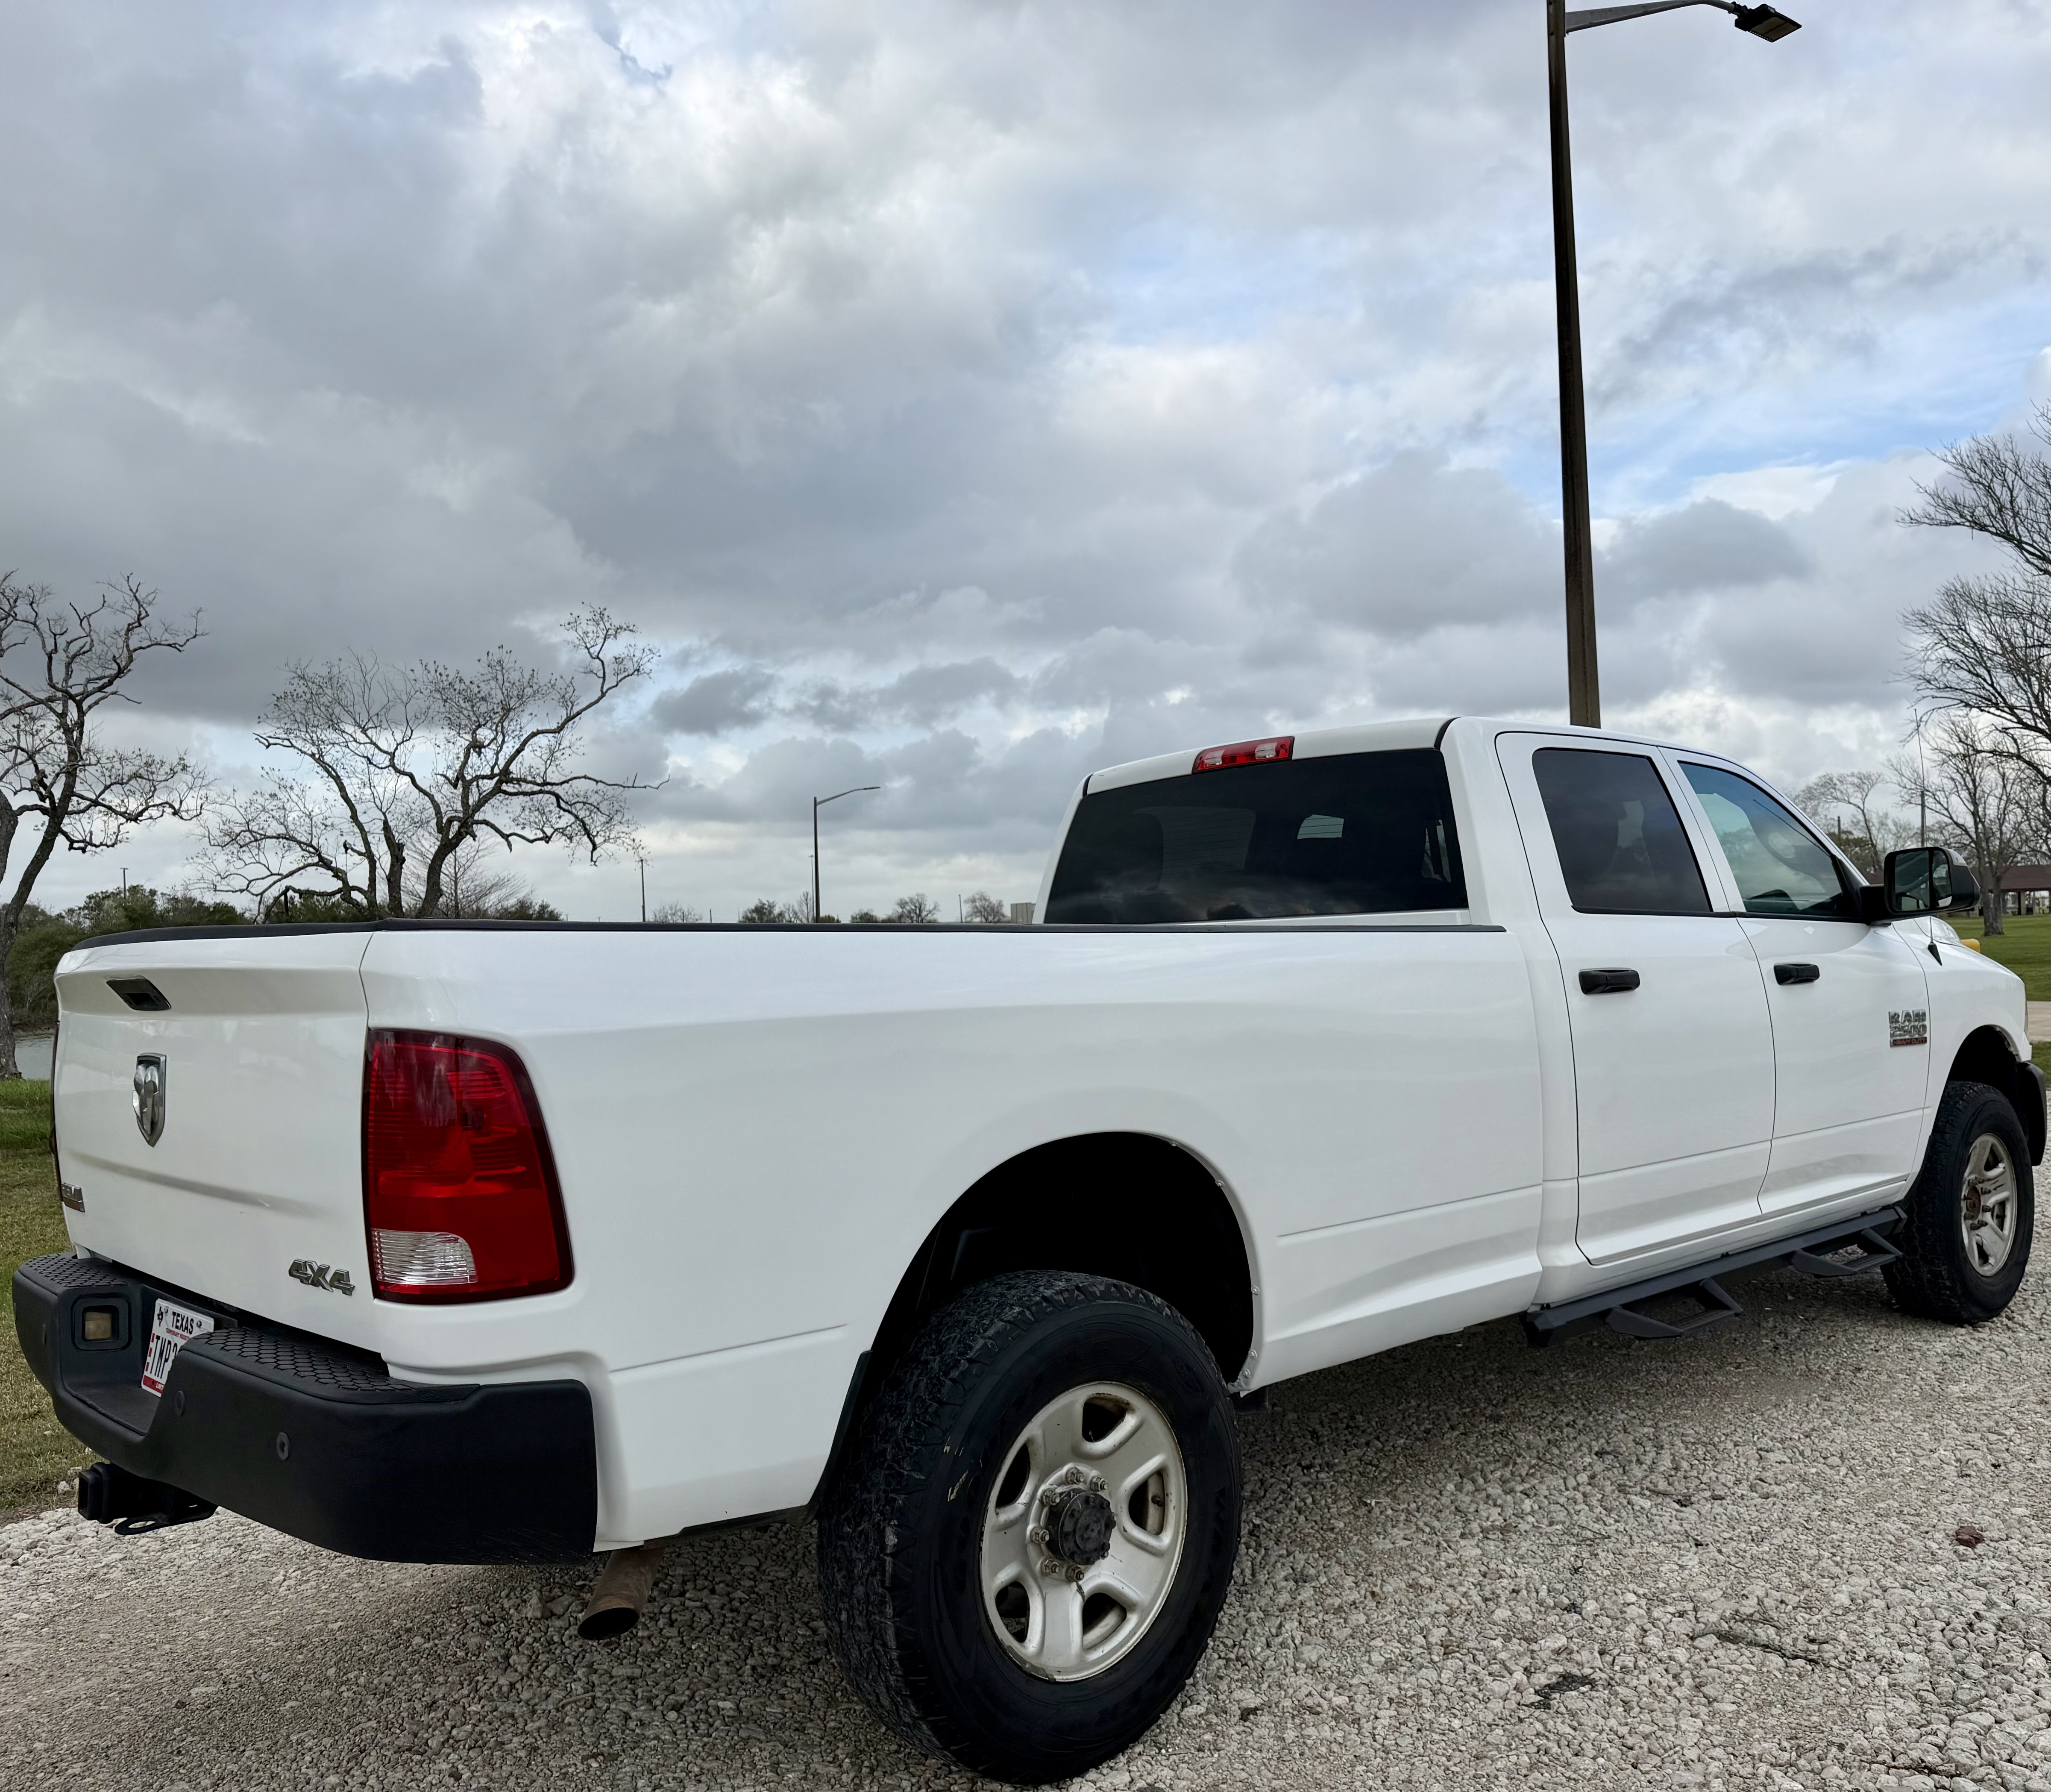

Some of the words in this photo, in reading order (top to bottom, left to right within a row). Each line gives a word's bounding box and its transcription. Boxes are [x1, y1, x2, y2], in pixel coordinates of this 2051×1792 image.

[1888, 1009, 1926, 1024] RAM
[1889, 1024, 1927, 1037] 2500
[172, 1311, 194, 1335] TEXAS
